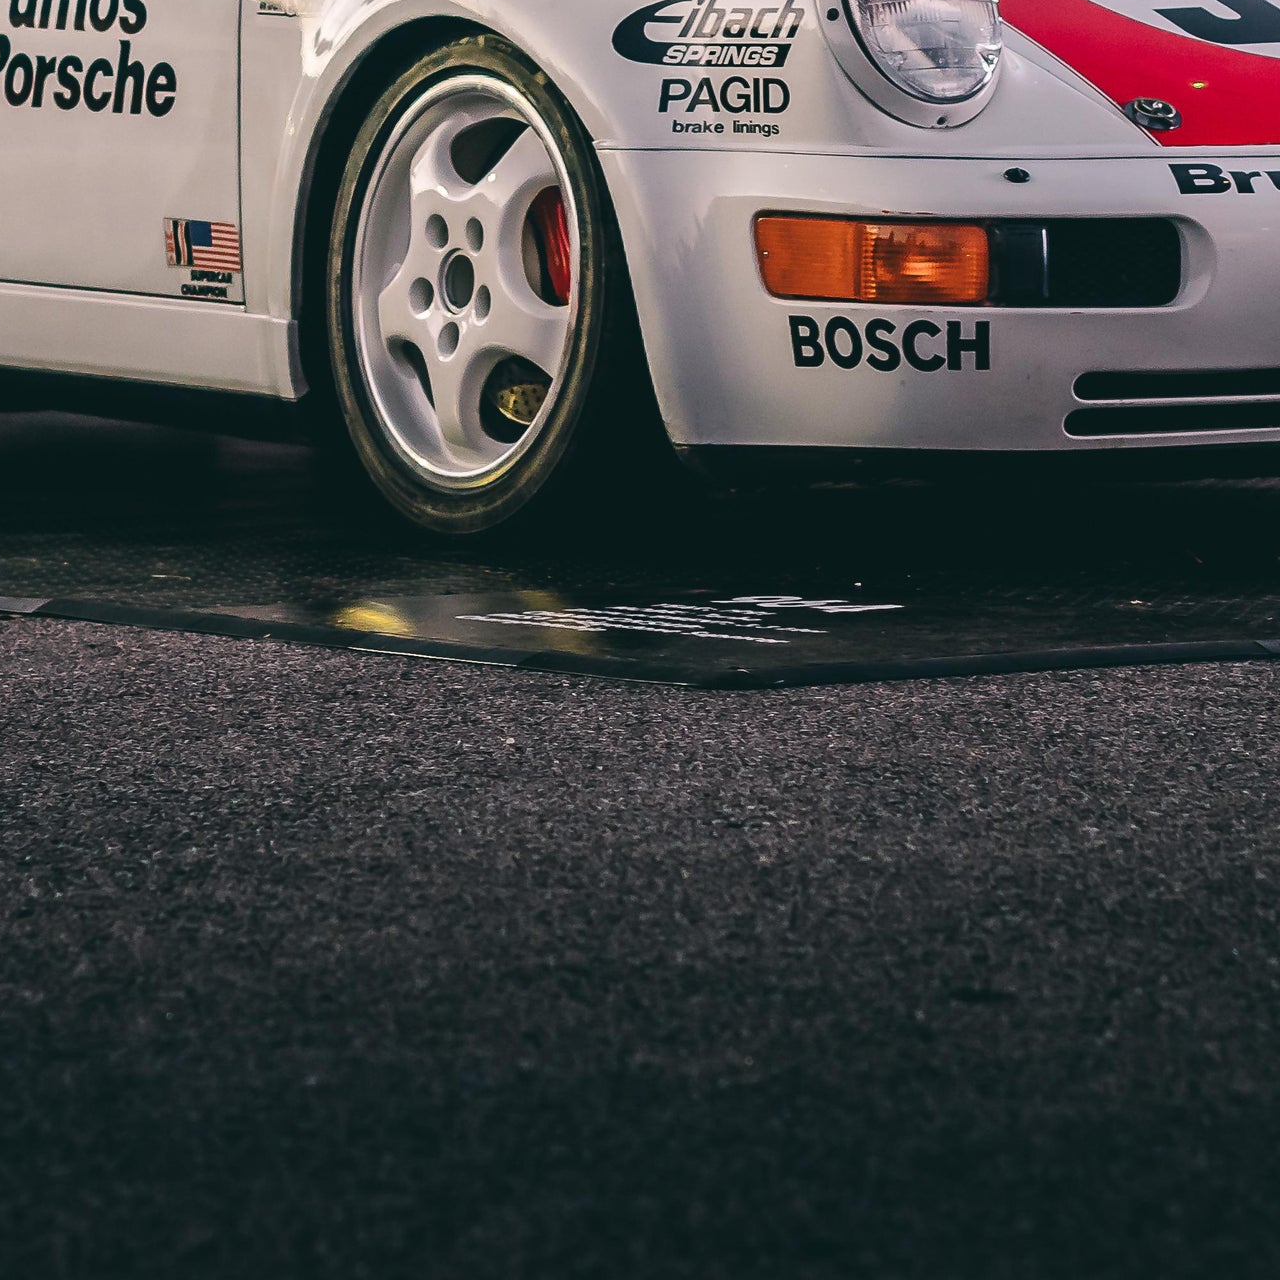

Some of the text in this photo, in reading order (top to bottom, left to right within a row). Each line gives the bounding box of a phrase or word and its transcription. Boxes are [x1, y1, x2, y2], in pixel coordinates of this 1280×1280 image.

[662, 45, 779, 66] SPRINGS
[657, 75, 791, 114] PAGID
[671, 119, 780, 137] brake linings
[788, 315, 991, 372] BOSCH
